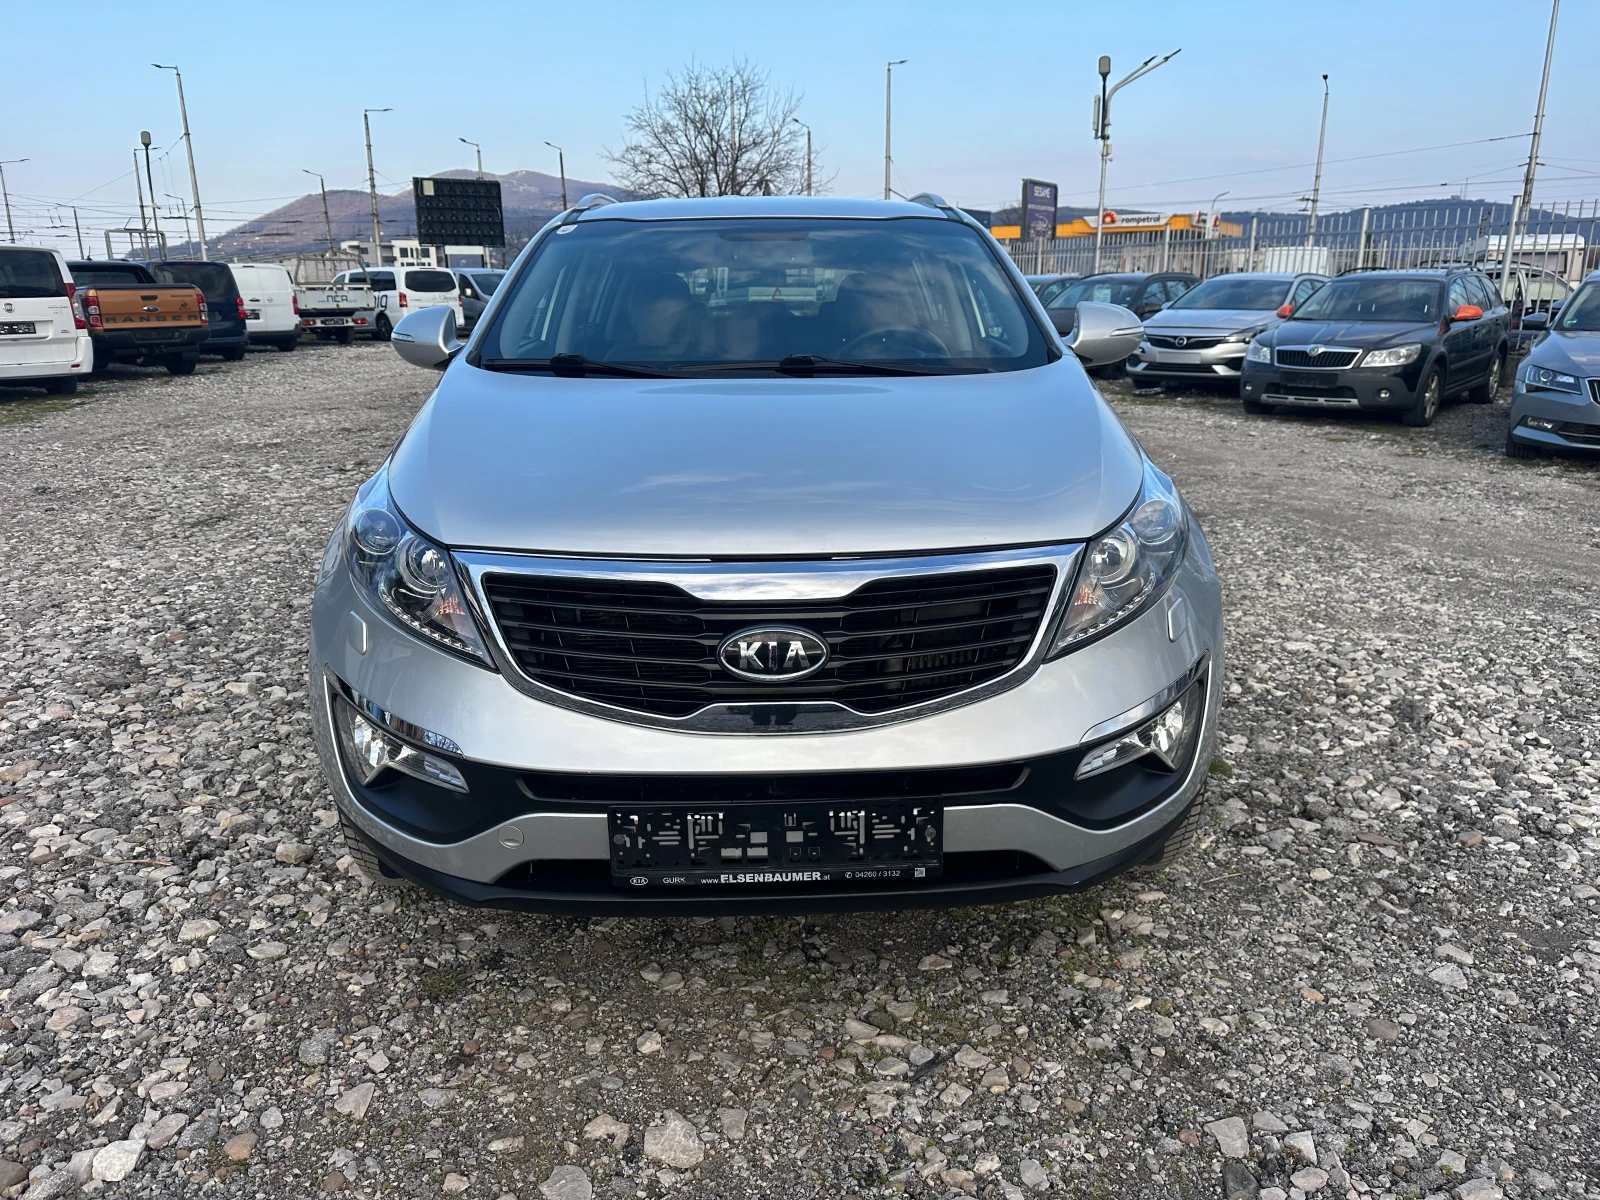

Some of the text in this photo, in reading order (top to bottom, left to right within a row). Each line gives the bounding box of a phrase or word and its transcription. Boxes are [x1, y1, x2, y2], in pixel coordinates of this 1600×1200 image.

[1121, 215, 1160, 225] rompetrol
[105, 314, 198, 323] RANGER
[737, 640, 811, 670] KIA
[662, 876, 686, 884] GURK
[701, 872, 831, 884] www.ELSENBAUMER.at
[883, 869, 901, 877] 3132
